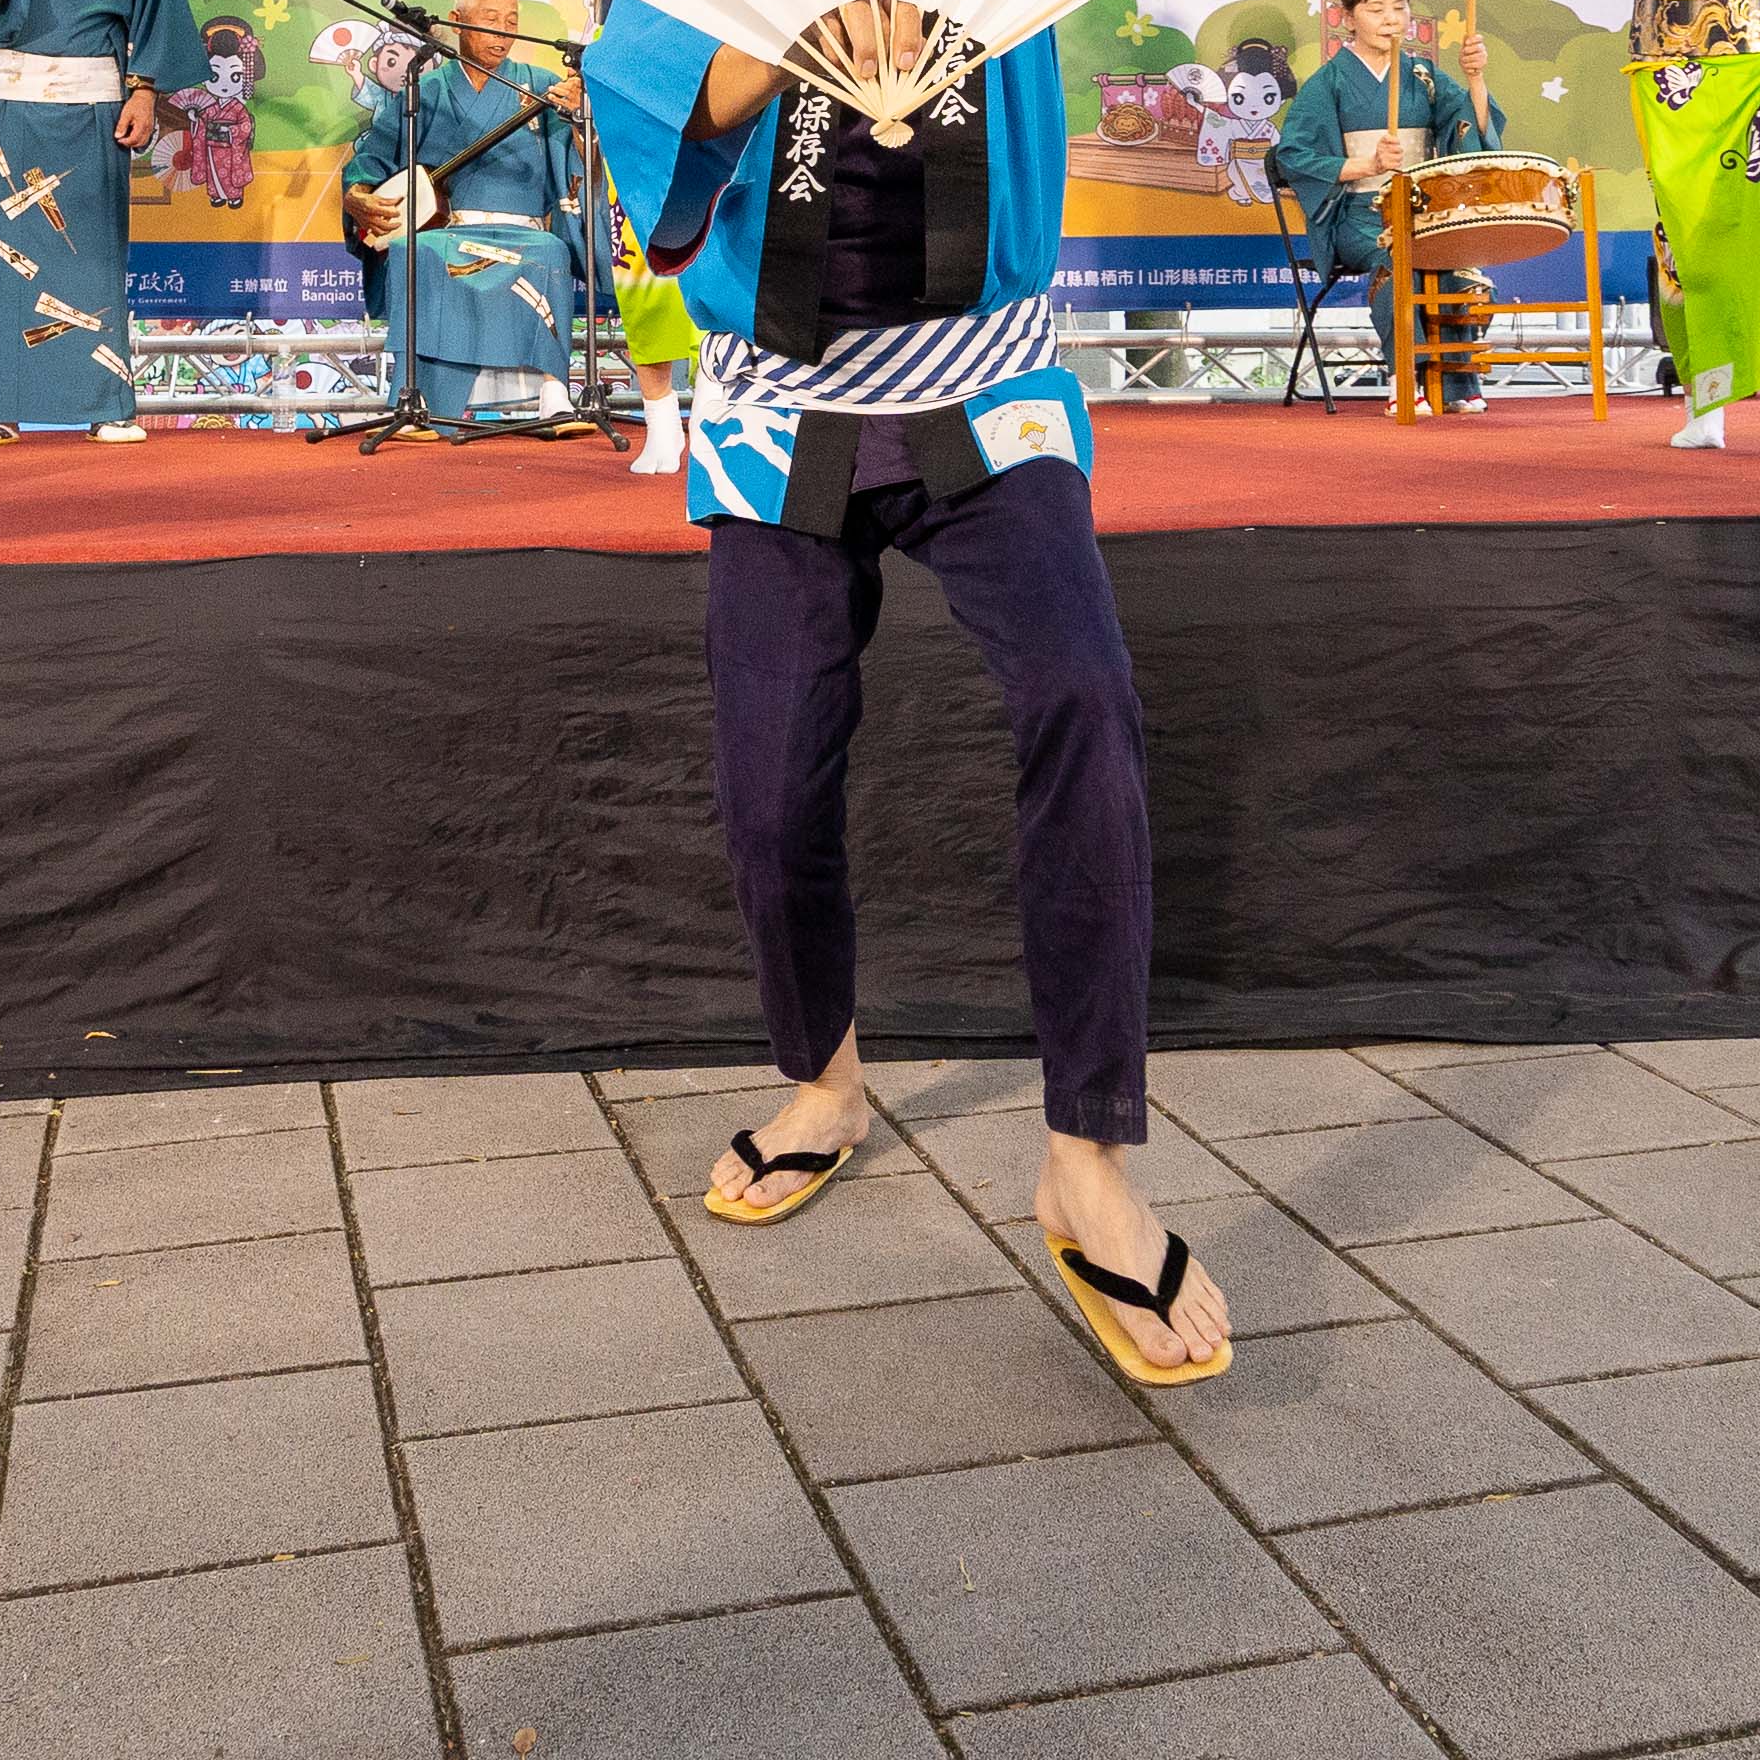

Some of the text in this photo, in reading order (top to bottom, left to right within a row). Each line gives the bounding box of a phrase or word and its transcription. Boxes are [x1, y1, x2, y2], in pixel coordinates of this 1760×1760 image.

[778, 81, 832, 202] 保存会
[229, 278, 288, 293] 主辦單位
[301, 289, 355, 304] Banqiao
